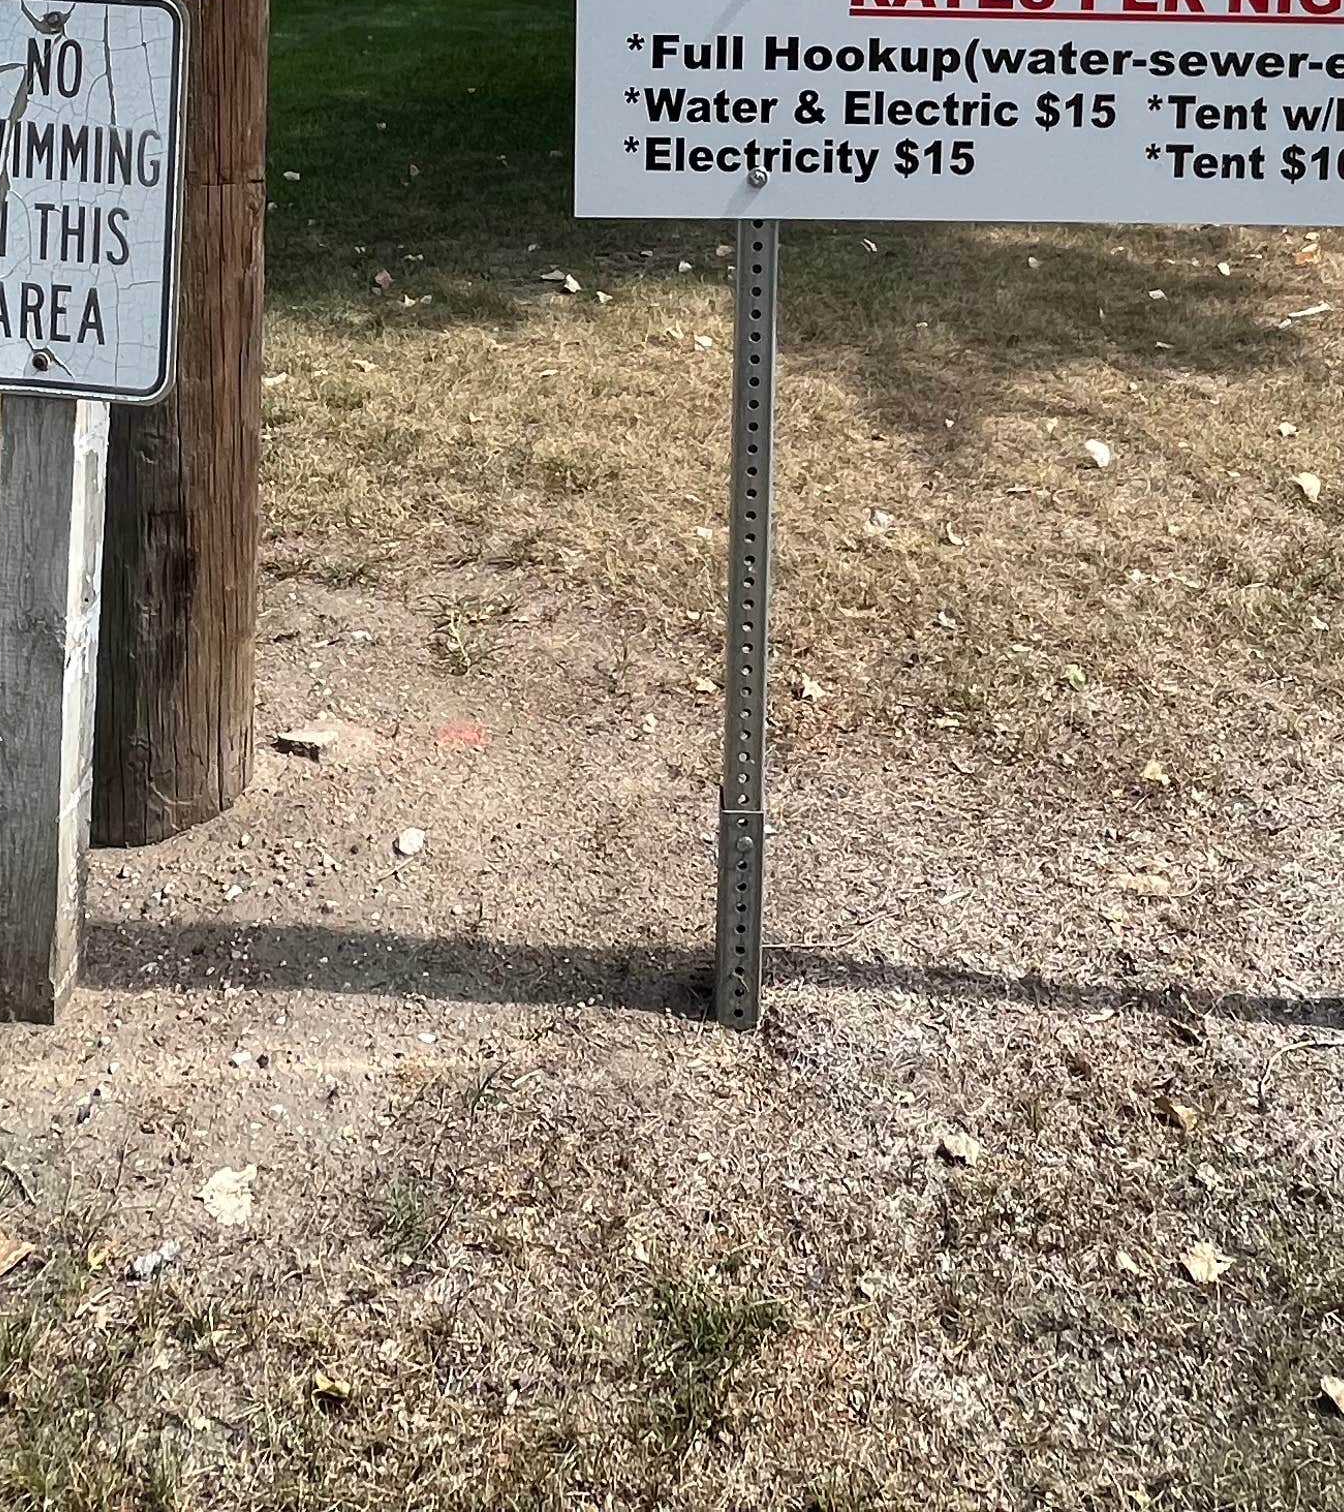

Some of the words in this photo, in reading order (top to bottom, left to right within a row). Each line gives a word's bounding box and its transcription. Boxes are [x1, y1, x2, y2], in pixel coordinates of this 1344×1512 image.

[27, 38, 82, 98] NO
[795, 90, 825, 124] &
[845, 91, 1018, 127] Electric
[1036, 91, 1115, 131] $15
[894, 138, 974, 178] $15
[35, 203, 129, 265] THIS
